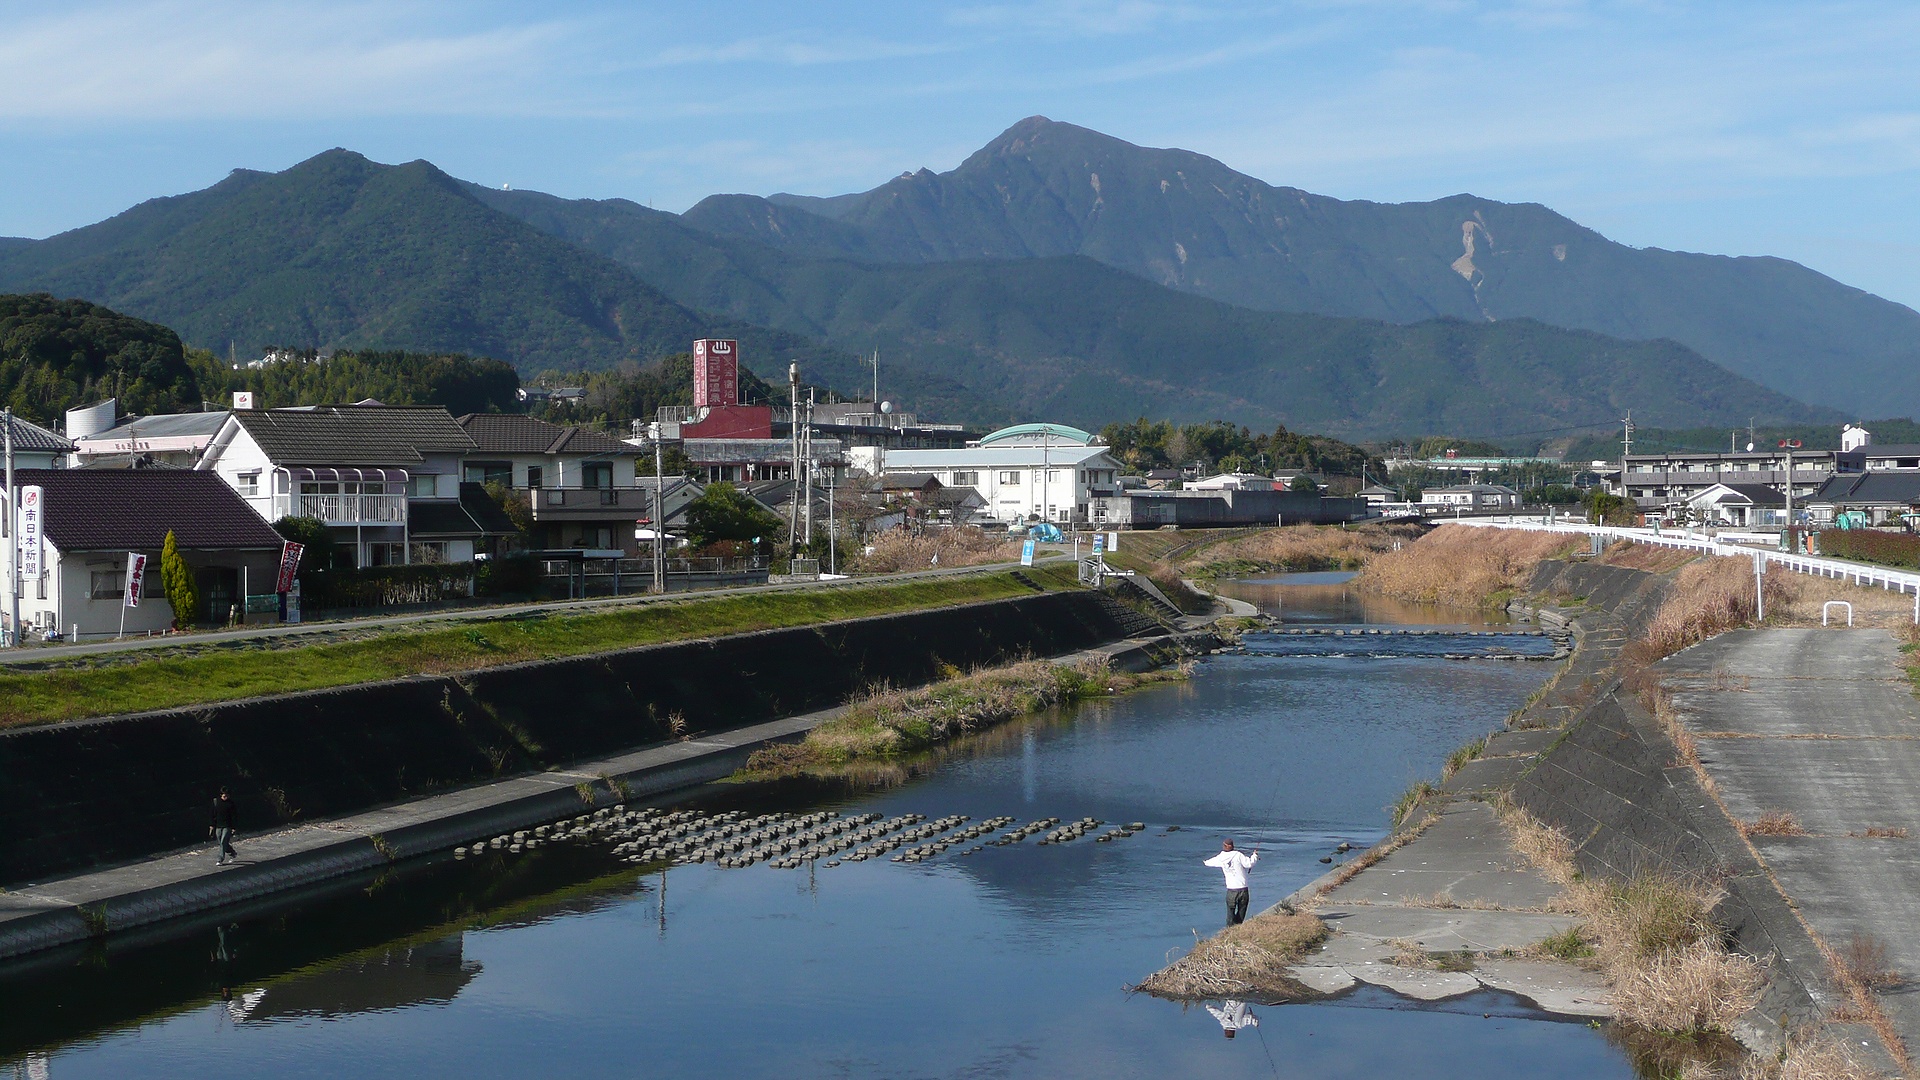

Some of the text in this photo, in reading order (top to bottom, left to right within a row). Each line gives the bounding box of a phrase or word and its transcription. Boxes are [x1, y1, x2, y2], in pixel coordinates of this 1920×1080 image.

[709, 356, 721, 402] ラドン温泉
[25, 509, 37, 574] 南日本新聞
